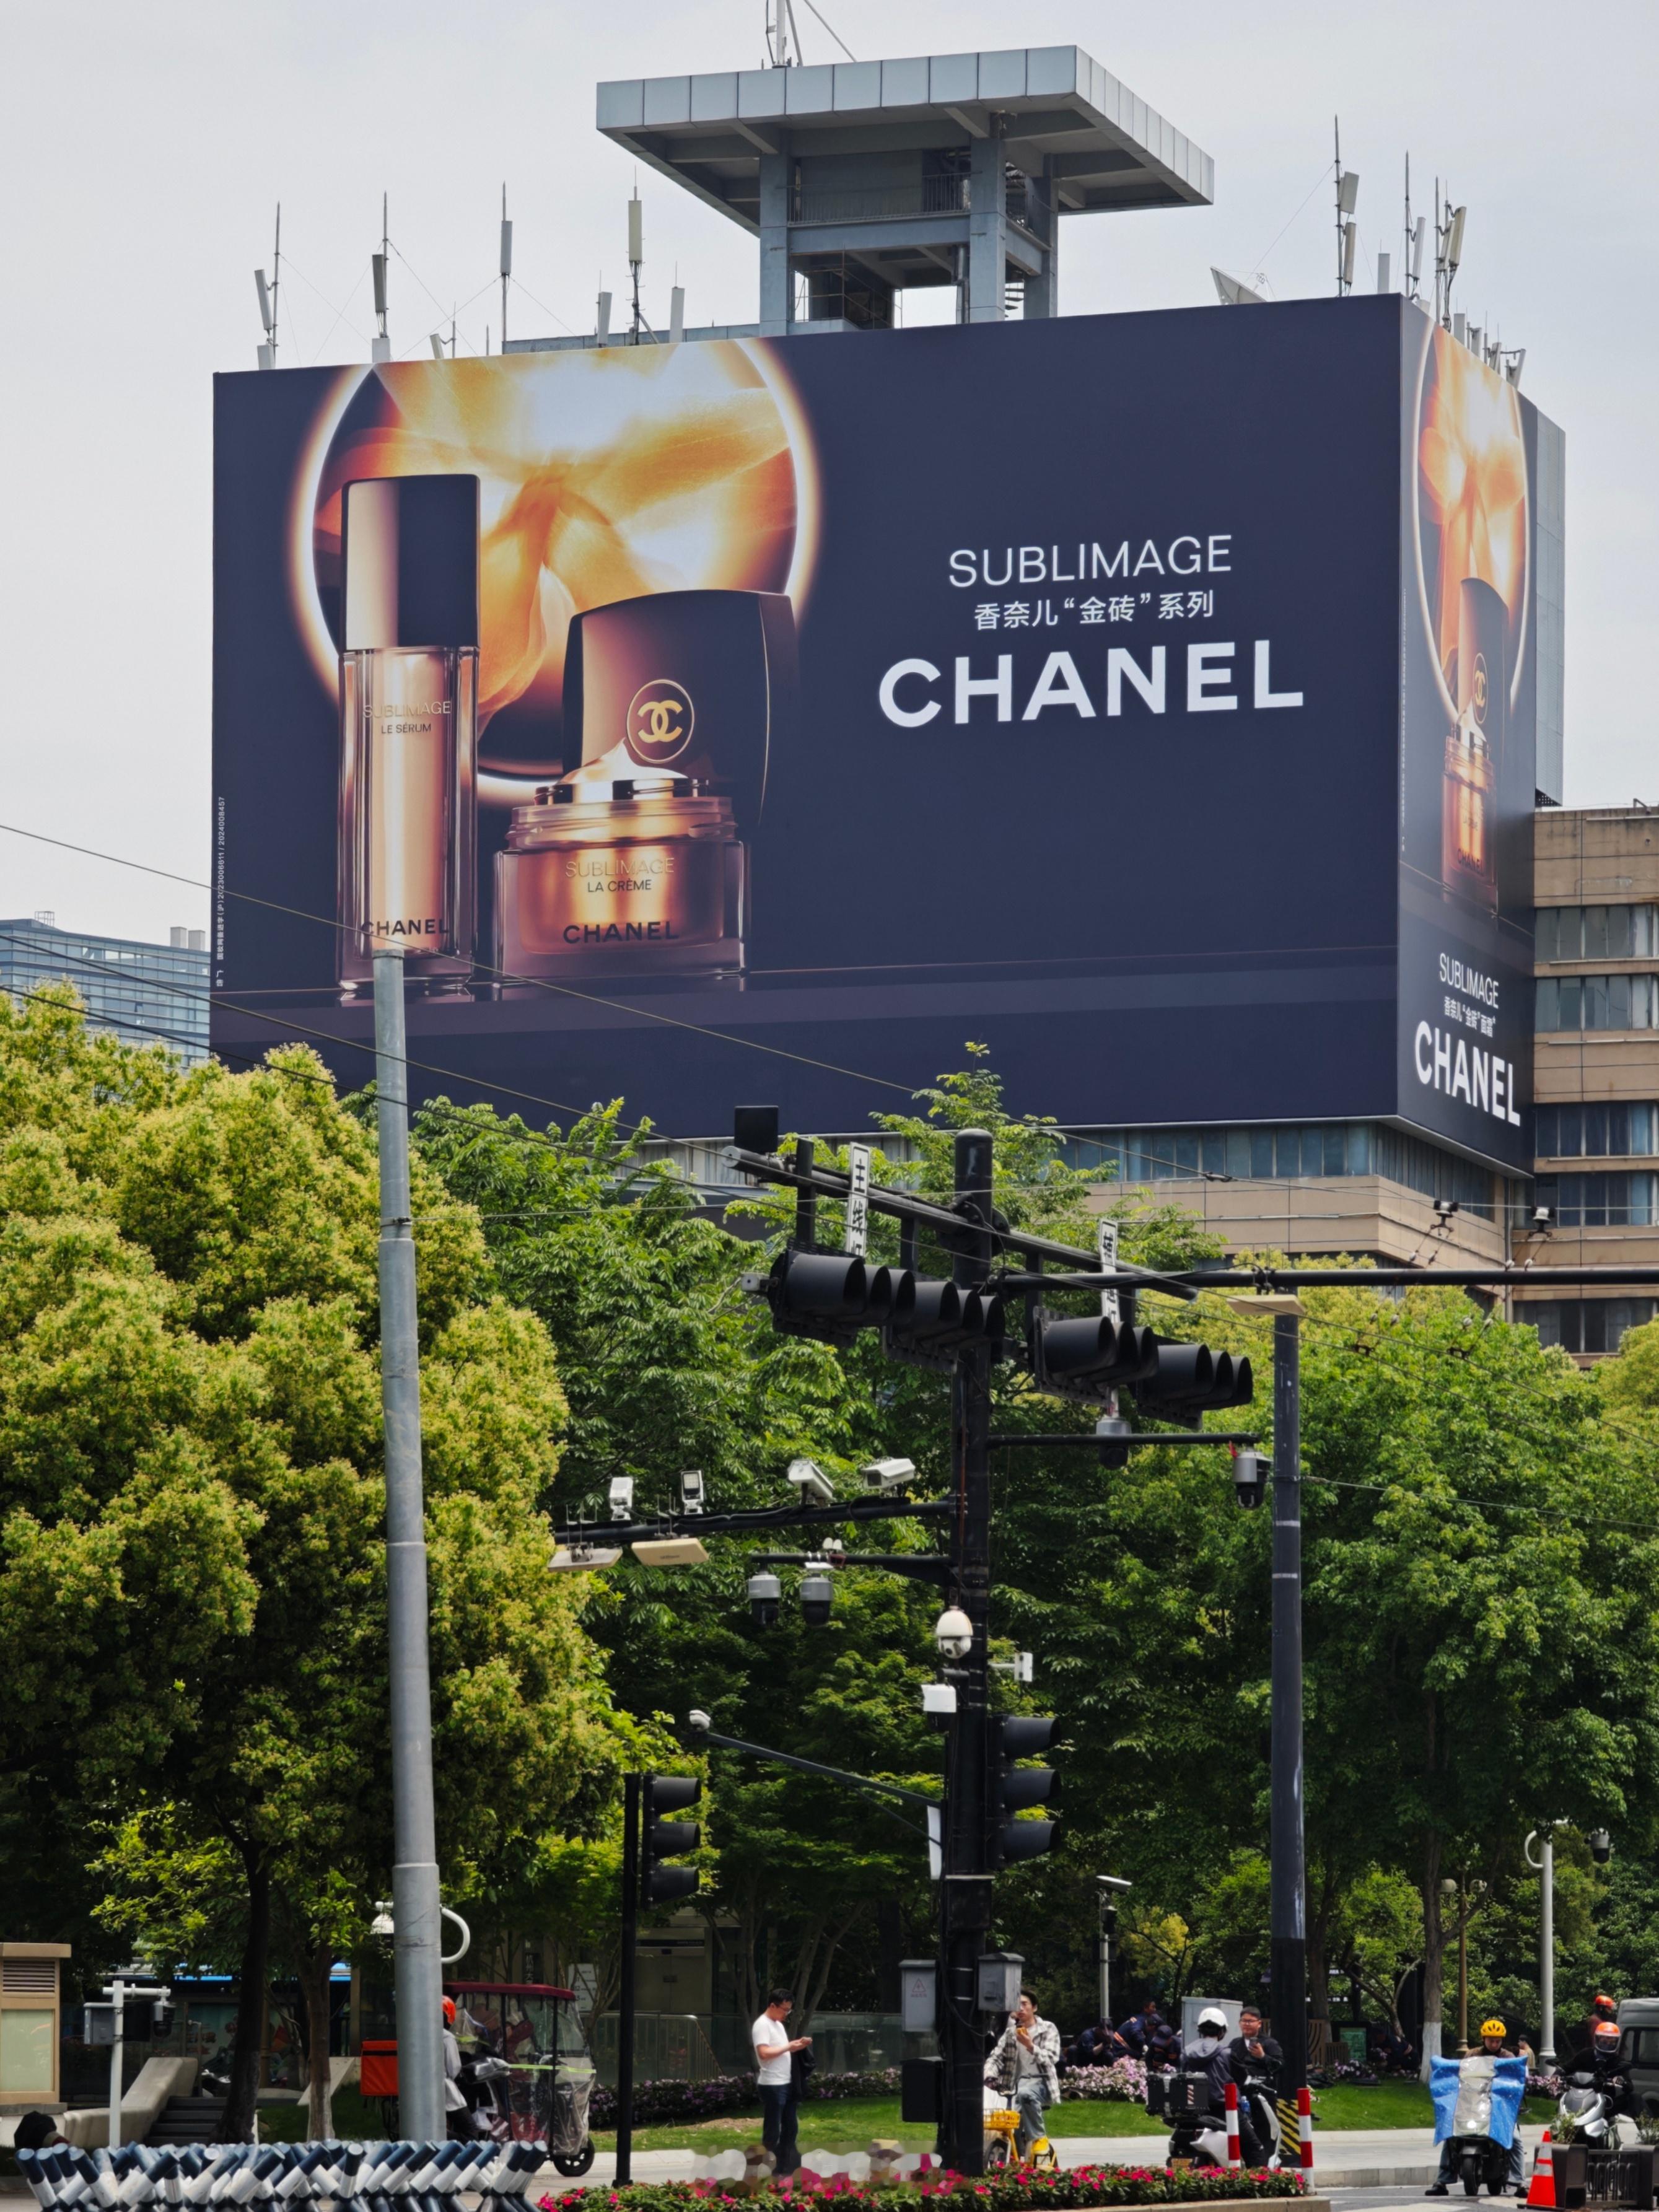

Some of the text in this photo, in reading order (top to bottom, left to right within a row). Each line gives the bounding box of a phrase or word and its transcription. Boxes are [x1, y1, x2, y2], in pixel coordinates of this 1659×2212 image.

[949, 534, 1232, 588] SUBLIMAGE
[974, 590, 1214, 631] 香奈儿“金砖”系列
[879, 639, 1303, 728] CHANEL
[362, 701, 451, 719] SUBLIMAGE
[381, 722, 432, 734] LE SÉRUM
[564, 858, 675, 877] SUBLIMAGE
[587, 878, 652, 893] LA CRÈME
[361, 919, 449, 937] CHANEL
[563, 921, 680, 944] CHANEL
[1439, 952, 1499, 1009] SUBLIMAGE
[1414, 1020, 1521, 1127] CHANEL
